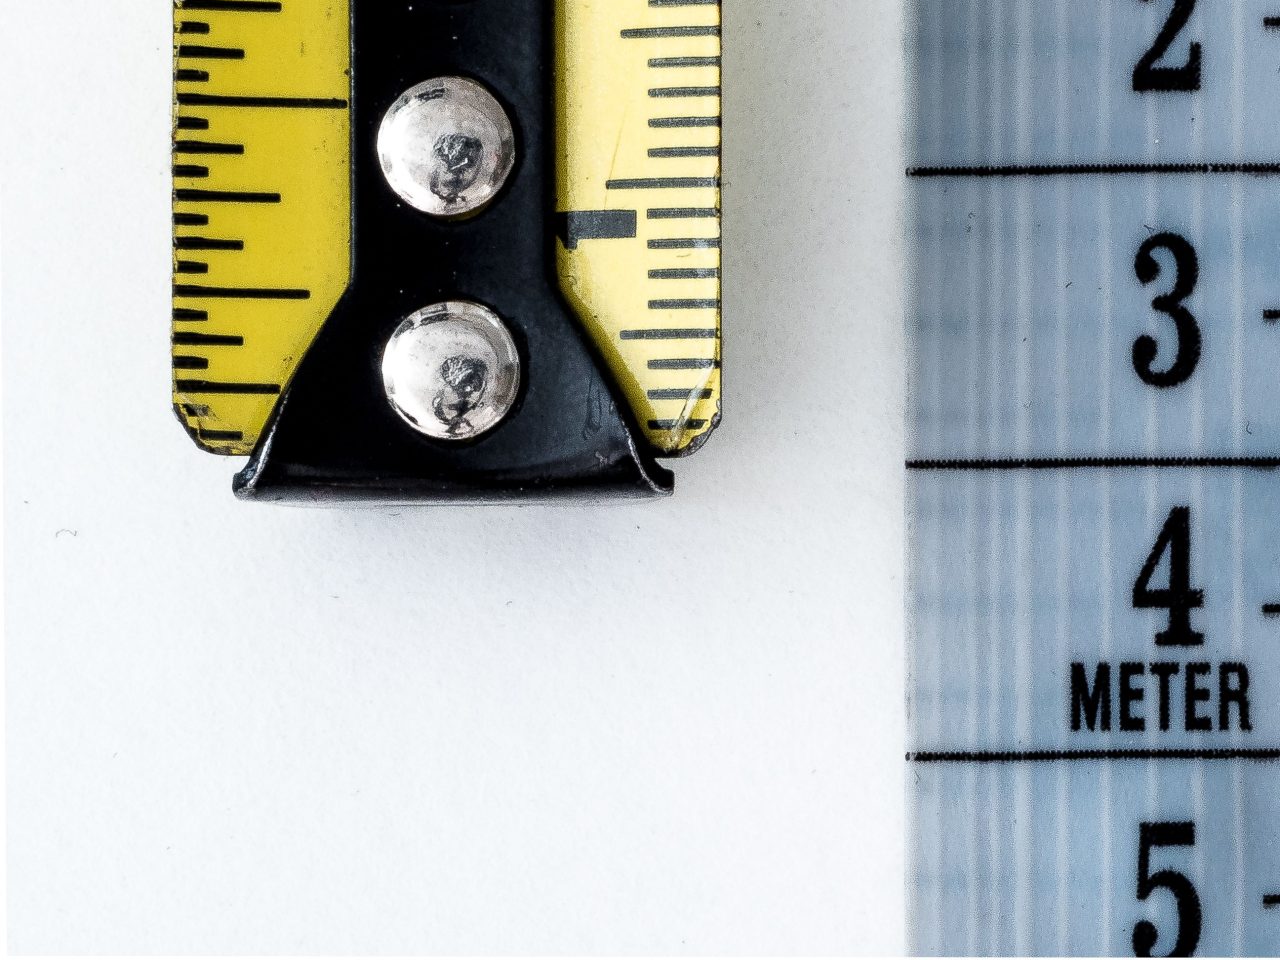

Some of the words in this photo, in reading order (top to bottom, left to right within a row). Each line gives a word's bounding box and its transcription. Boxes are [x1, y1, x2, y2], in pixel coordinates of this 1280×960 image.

[1132, 231, 1202, 387] 3
[1132, 506, 1204, 645] 4
[1070, 662, 1253, 732] METER
[1131, 822, 1203, 958] 5
